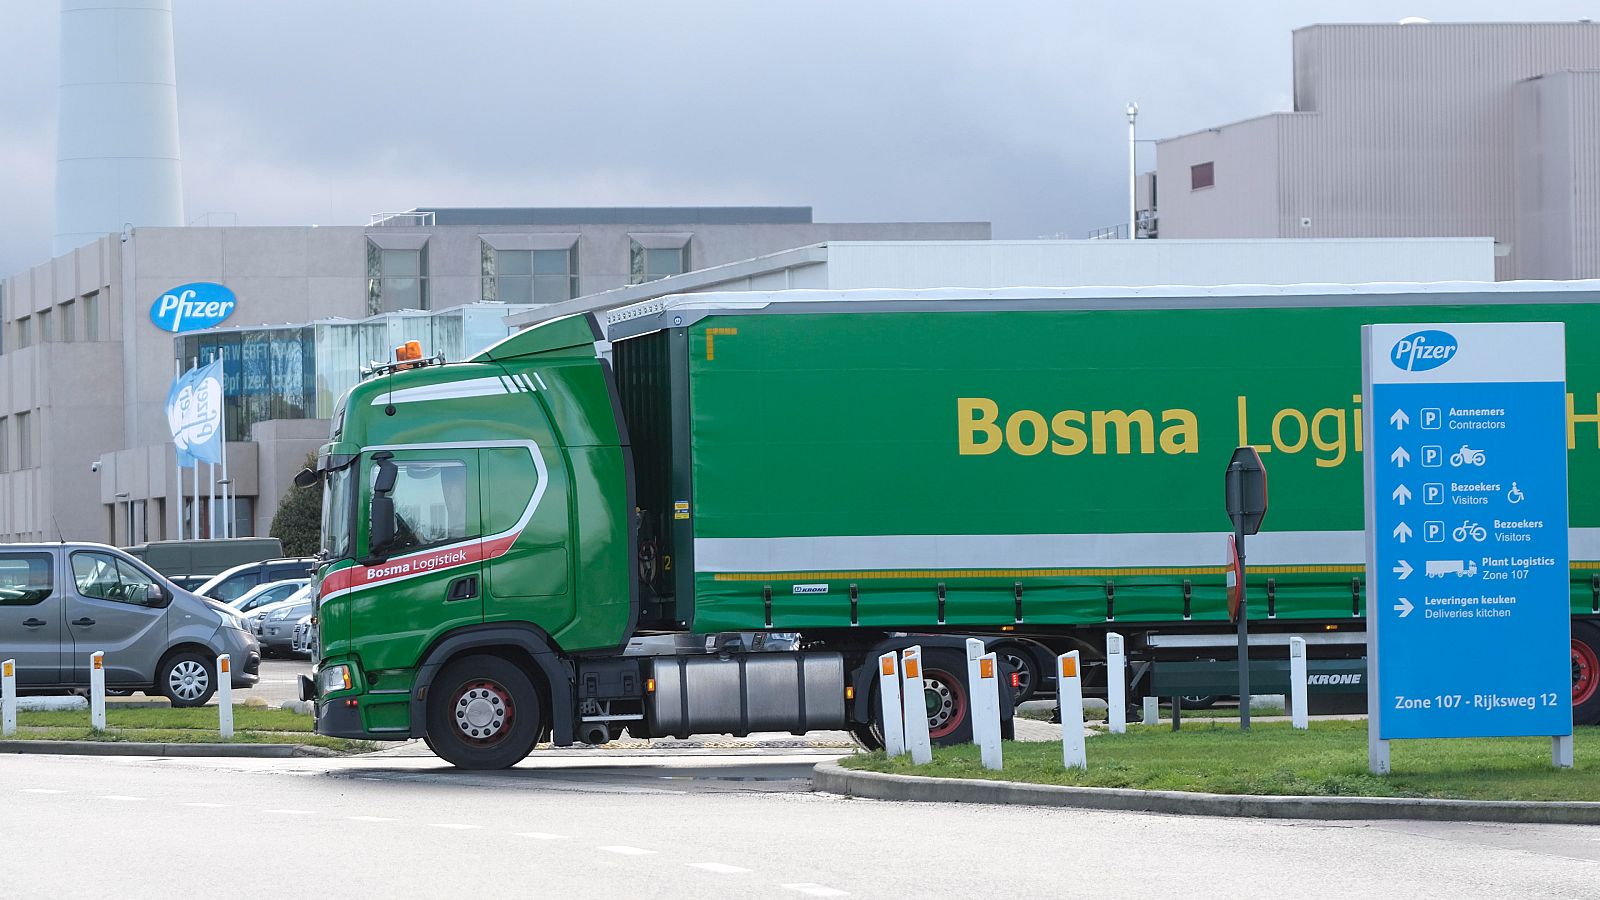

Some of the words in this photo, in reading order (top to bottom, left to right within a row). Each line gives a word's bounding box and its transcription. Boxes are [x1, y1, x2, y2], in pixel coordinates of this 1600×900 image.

[158, 289, 234, 332] Pfizer
[1395, 335, 1456, 372] Pfizer
[1449, 407, 1505, 417] Aannemers
[1449, 420, 1506, 430] Contractors
[957, 397, 1199, 456] Bosma
[1237, 394, 1363, 468] Logi
[1451, 482, 1501, 492] Bezoekers
[1451, 495, 1489, 505] Visitors
[1494, 519, 1544, 529] Bezoekers
[1494, 532, 1531, 542] Visitors
[367, 564, 410, 579] Bosma
[413, 550, 466, 570] Logistiek
[664, 555, 671, 570] 2
[1482, 557, 1509, 567] Plant
[1511, 556, 1555, 569] Logistics
[1482, 570, 1508, 580] Zone
[1511, 569, 1529, 579] 107
[1425, 596, 1479, 607] Leveringen
[1481, 594, 1516, 605] keuken
[1425, 608, 1474, 619] Deliveries
[1476, 608, 1511, 618] kitchen
[1307, 674, 1361, 685] KRONE
[1394, 695, 1431, 709] Zone
[1435, 694, 1462, 708] 107
[1474, 693, 1536, 711] Rijksweg
[1540, 693, 1557, 706] 12
